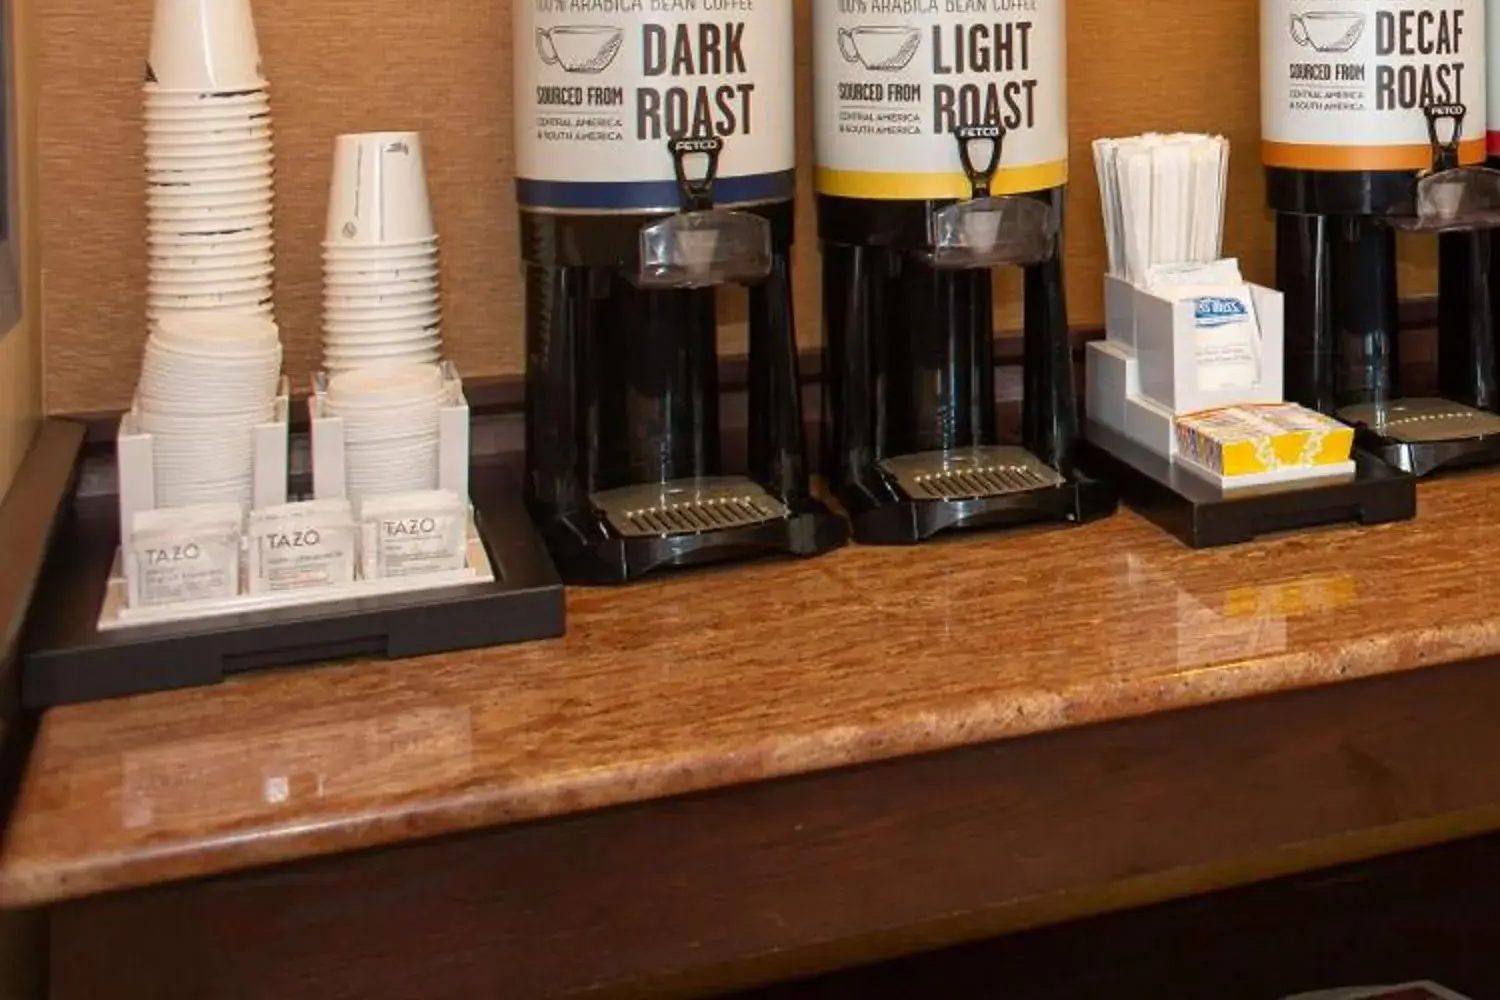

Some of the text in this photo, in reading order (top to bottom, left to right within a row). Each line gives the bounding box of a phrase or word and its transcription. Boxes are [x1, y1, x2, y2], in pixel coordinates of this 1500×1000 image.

[643, 21, 747, 76] DARK
[932, 21, 1032, 74] LIGHT
[1376, 9, 1464, 56] DECAF
[1289, 63, 1365, 81] SOURCED FROM
[1376, 62, 1465, 110] ROAST
[537, 87, 623, 106] SOURCED FROM
[838, 83, 921, 102] SOURCED FROM
[933, 79, 1038, 135] ROAST
[637, 83, 755, 140] ROAST
[266, 529, 320, 550] TAZO
[384, 517, 435, 536] TAZO
[144, 542, 200, 566] TAZO
